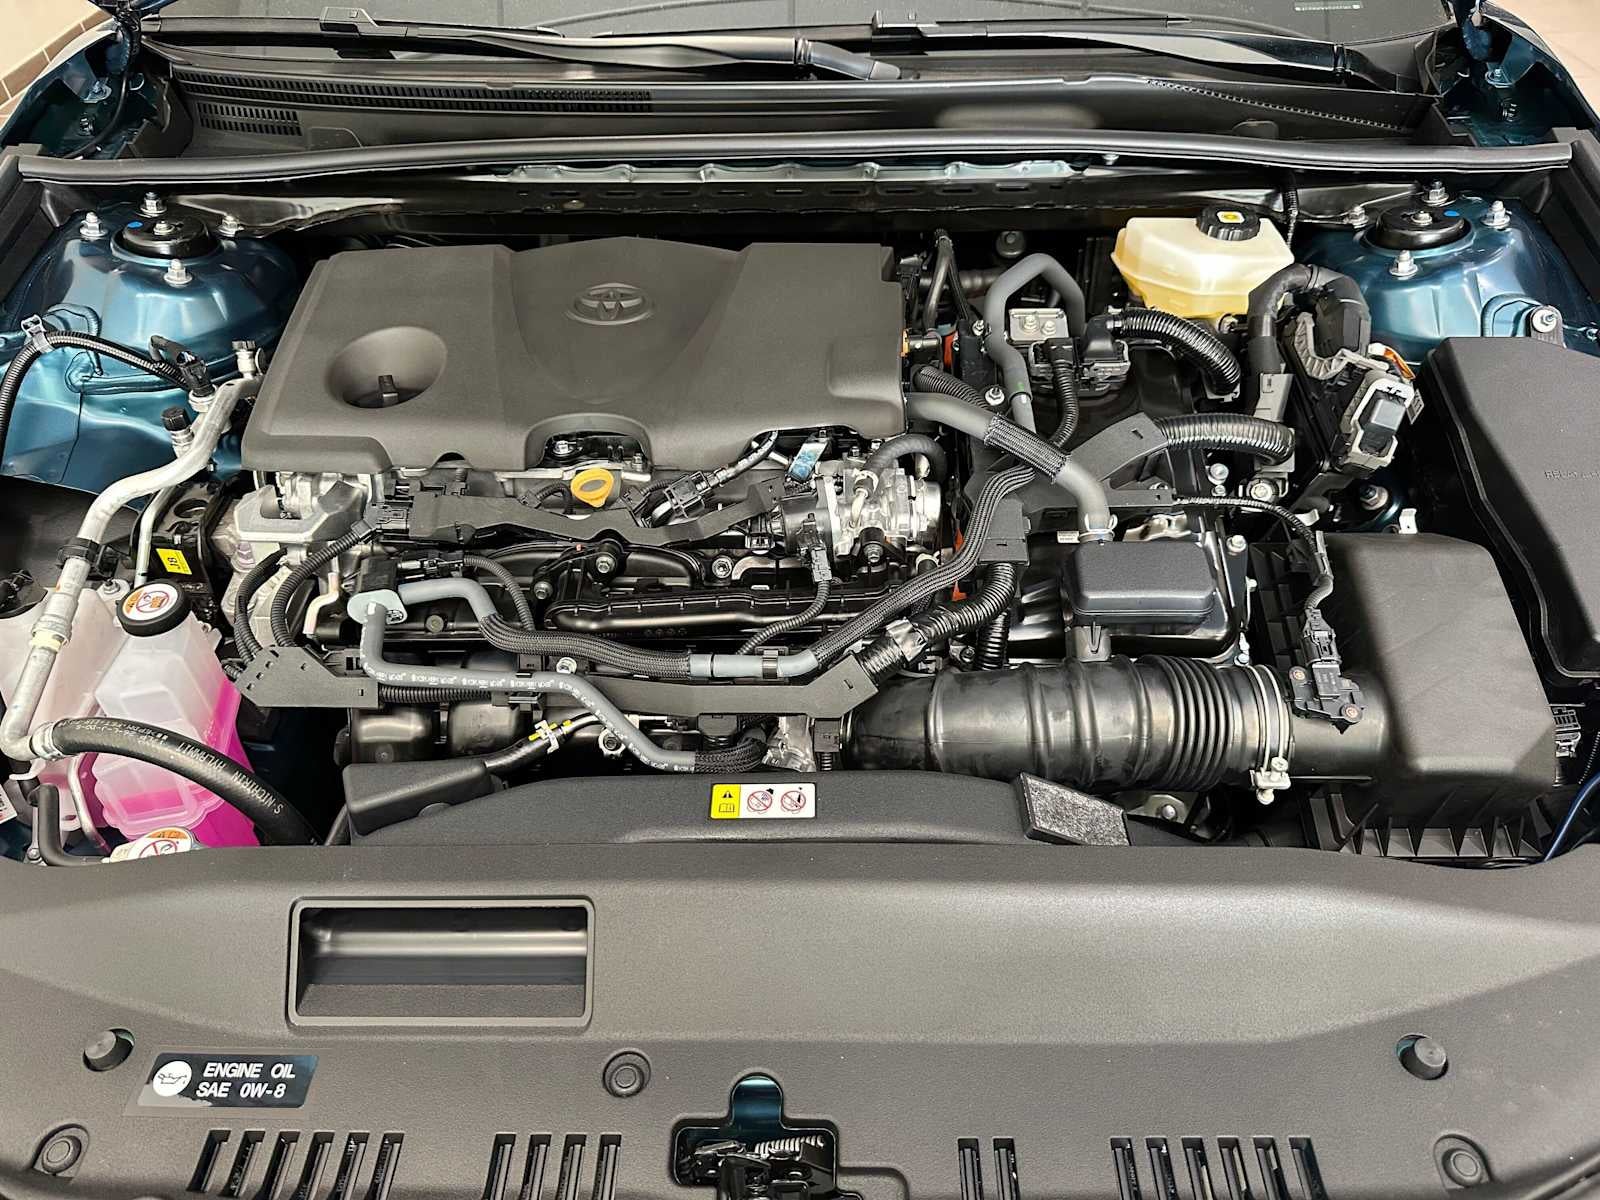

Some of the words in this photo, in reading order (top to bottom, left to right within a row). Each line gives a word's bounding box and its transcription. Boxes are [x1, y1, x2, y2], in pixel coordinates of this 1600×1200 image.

[203, 1062, 264, 1078] ENGINE
[271, 1063, 297, 1079] OIL
[195, 1081, 232, 1098] SAE
[239, 1082, 287, 1099] 0W-8
